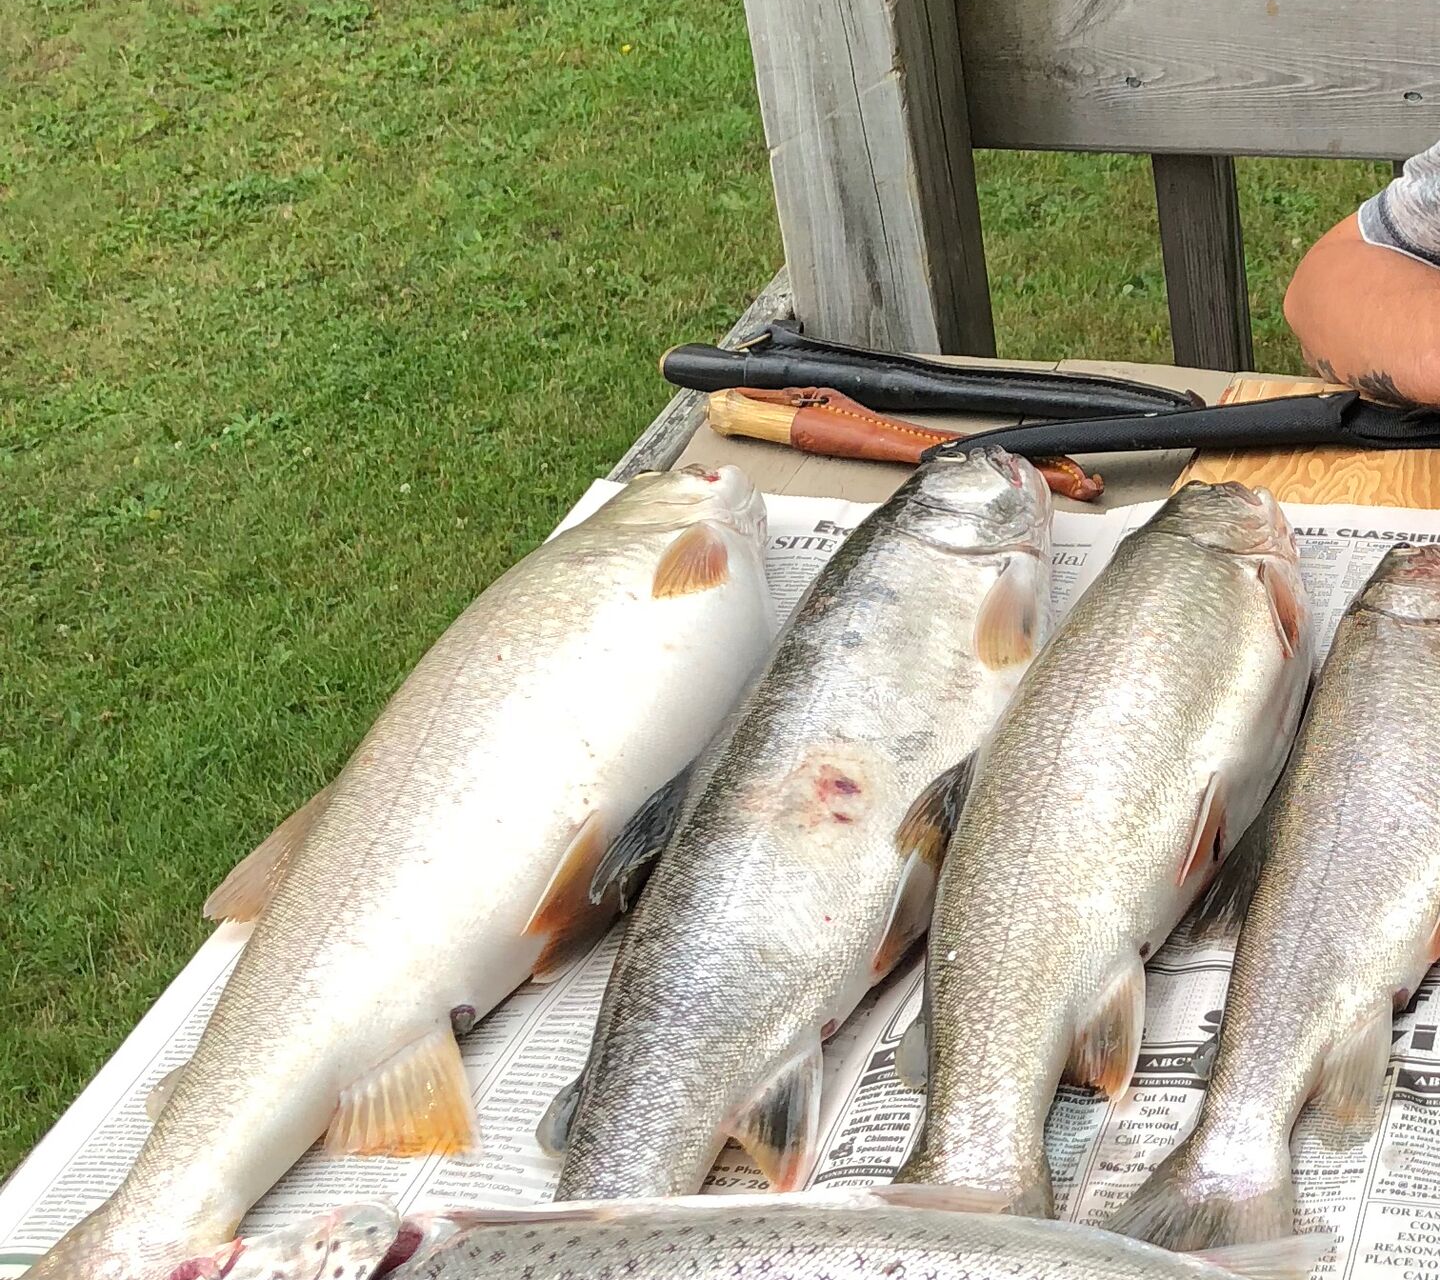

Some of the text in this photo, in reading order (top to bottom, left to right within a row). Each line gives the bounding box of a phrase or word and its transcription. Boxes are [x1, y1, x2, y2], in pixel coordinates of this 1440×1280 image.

[859, 1082, 901, 1095] ROOFTOP
[854, 1092, 882, 1103] SNOW
[1133, 1092, 1187, 1103] Cut And
[1139, 1106, 1171, 1116] Split
[849, 1115, 870, 1126] DAN
[841, 1123, 911, 1137] CONTRACTING
[864, 1135, 906, 1143] Chimney
[1115, 1134, 1176, 1146] Call Zeph
[856, 1145, 904, 1153] Specialists
[1133, 1150, 1145, 1159] at
[1410, 1157, 1440, 1167] Insured
[469, 1171, 494, 1181] 50mg
[818, 1167, 893, 1181] CONSTRUCTION
[459, 1189, 479, 1199] 1mg
[1093, 1189, 1114, 1198] FOR
[1304, 1205, 1346, 1216] EASY TO
[1381, 1206, 1411, 1216] FOR
[1364, 1254, 1413, 1267] PLACE
